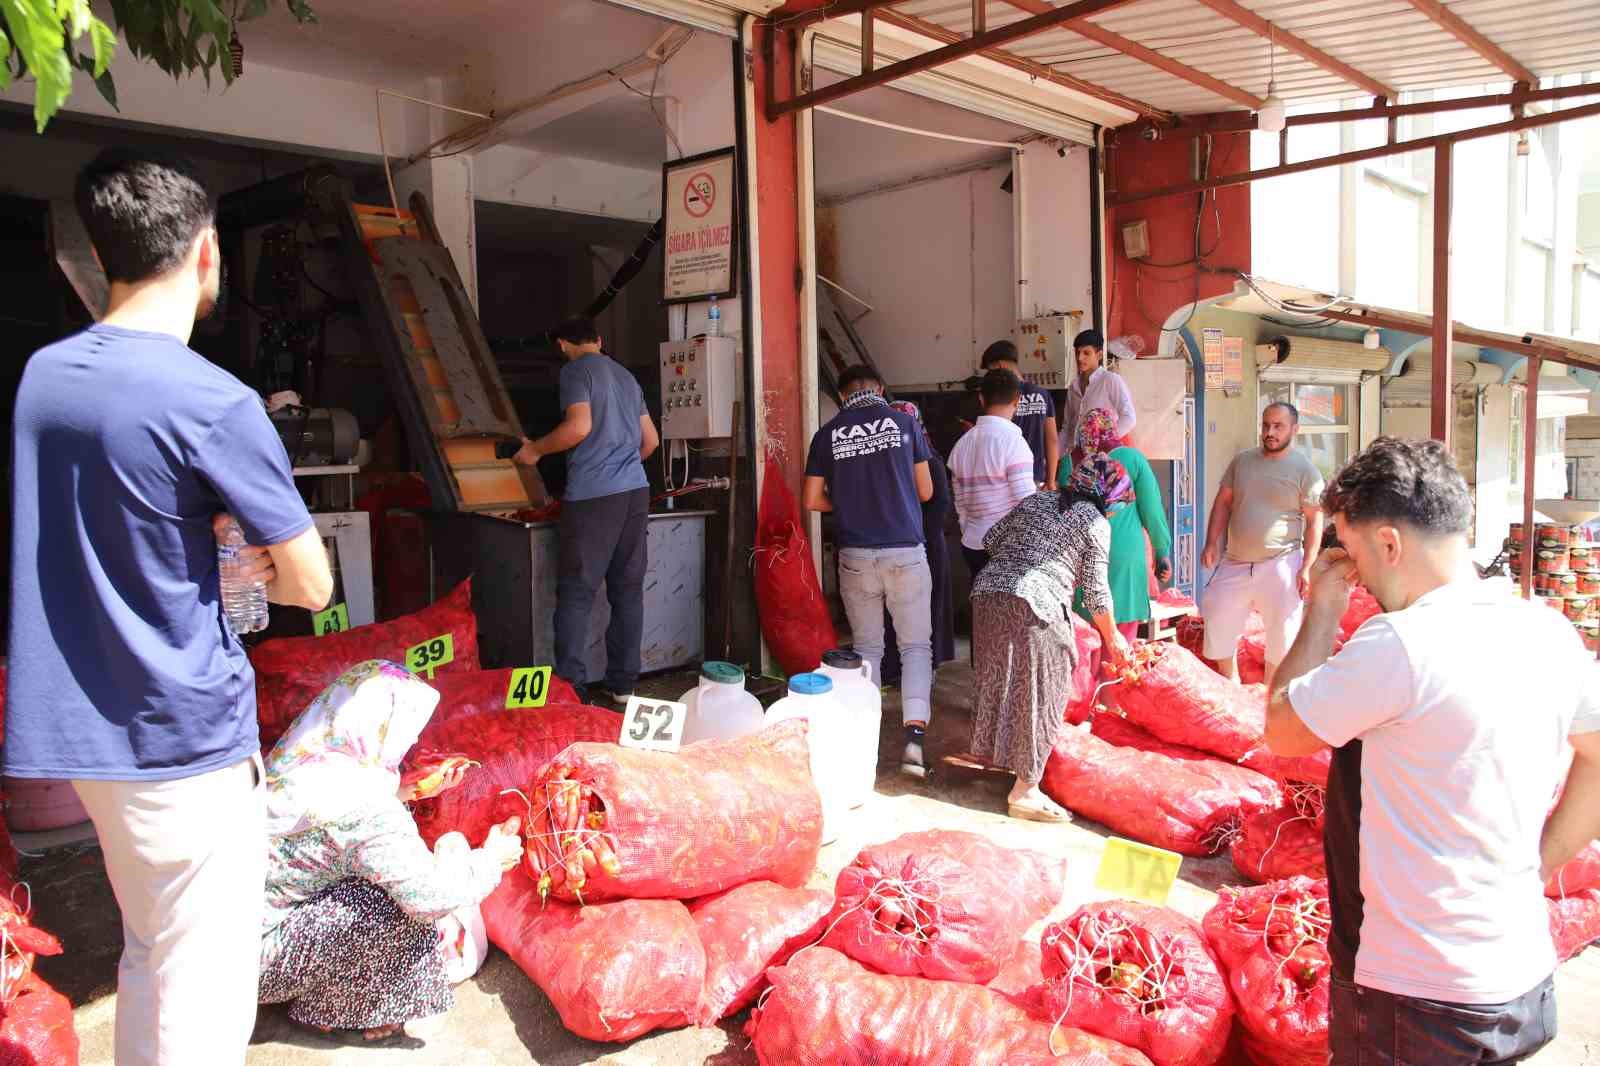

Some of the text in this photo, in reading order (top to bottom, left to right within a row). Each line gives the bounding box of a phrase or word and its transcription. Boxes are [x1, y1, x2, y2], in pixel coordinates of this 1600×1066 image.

[1018, 392, 1045, 404] AYA
[831, 417, 900, 443] KAYA
[412, 639, 446, 669] 39
[512, 669, 545, 704] 40
[628, 704, 675, 741] 52
